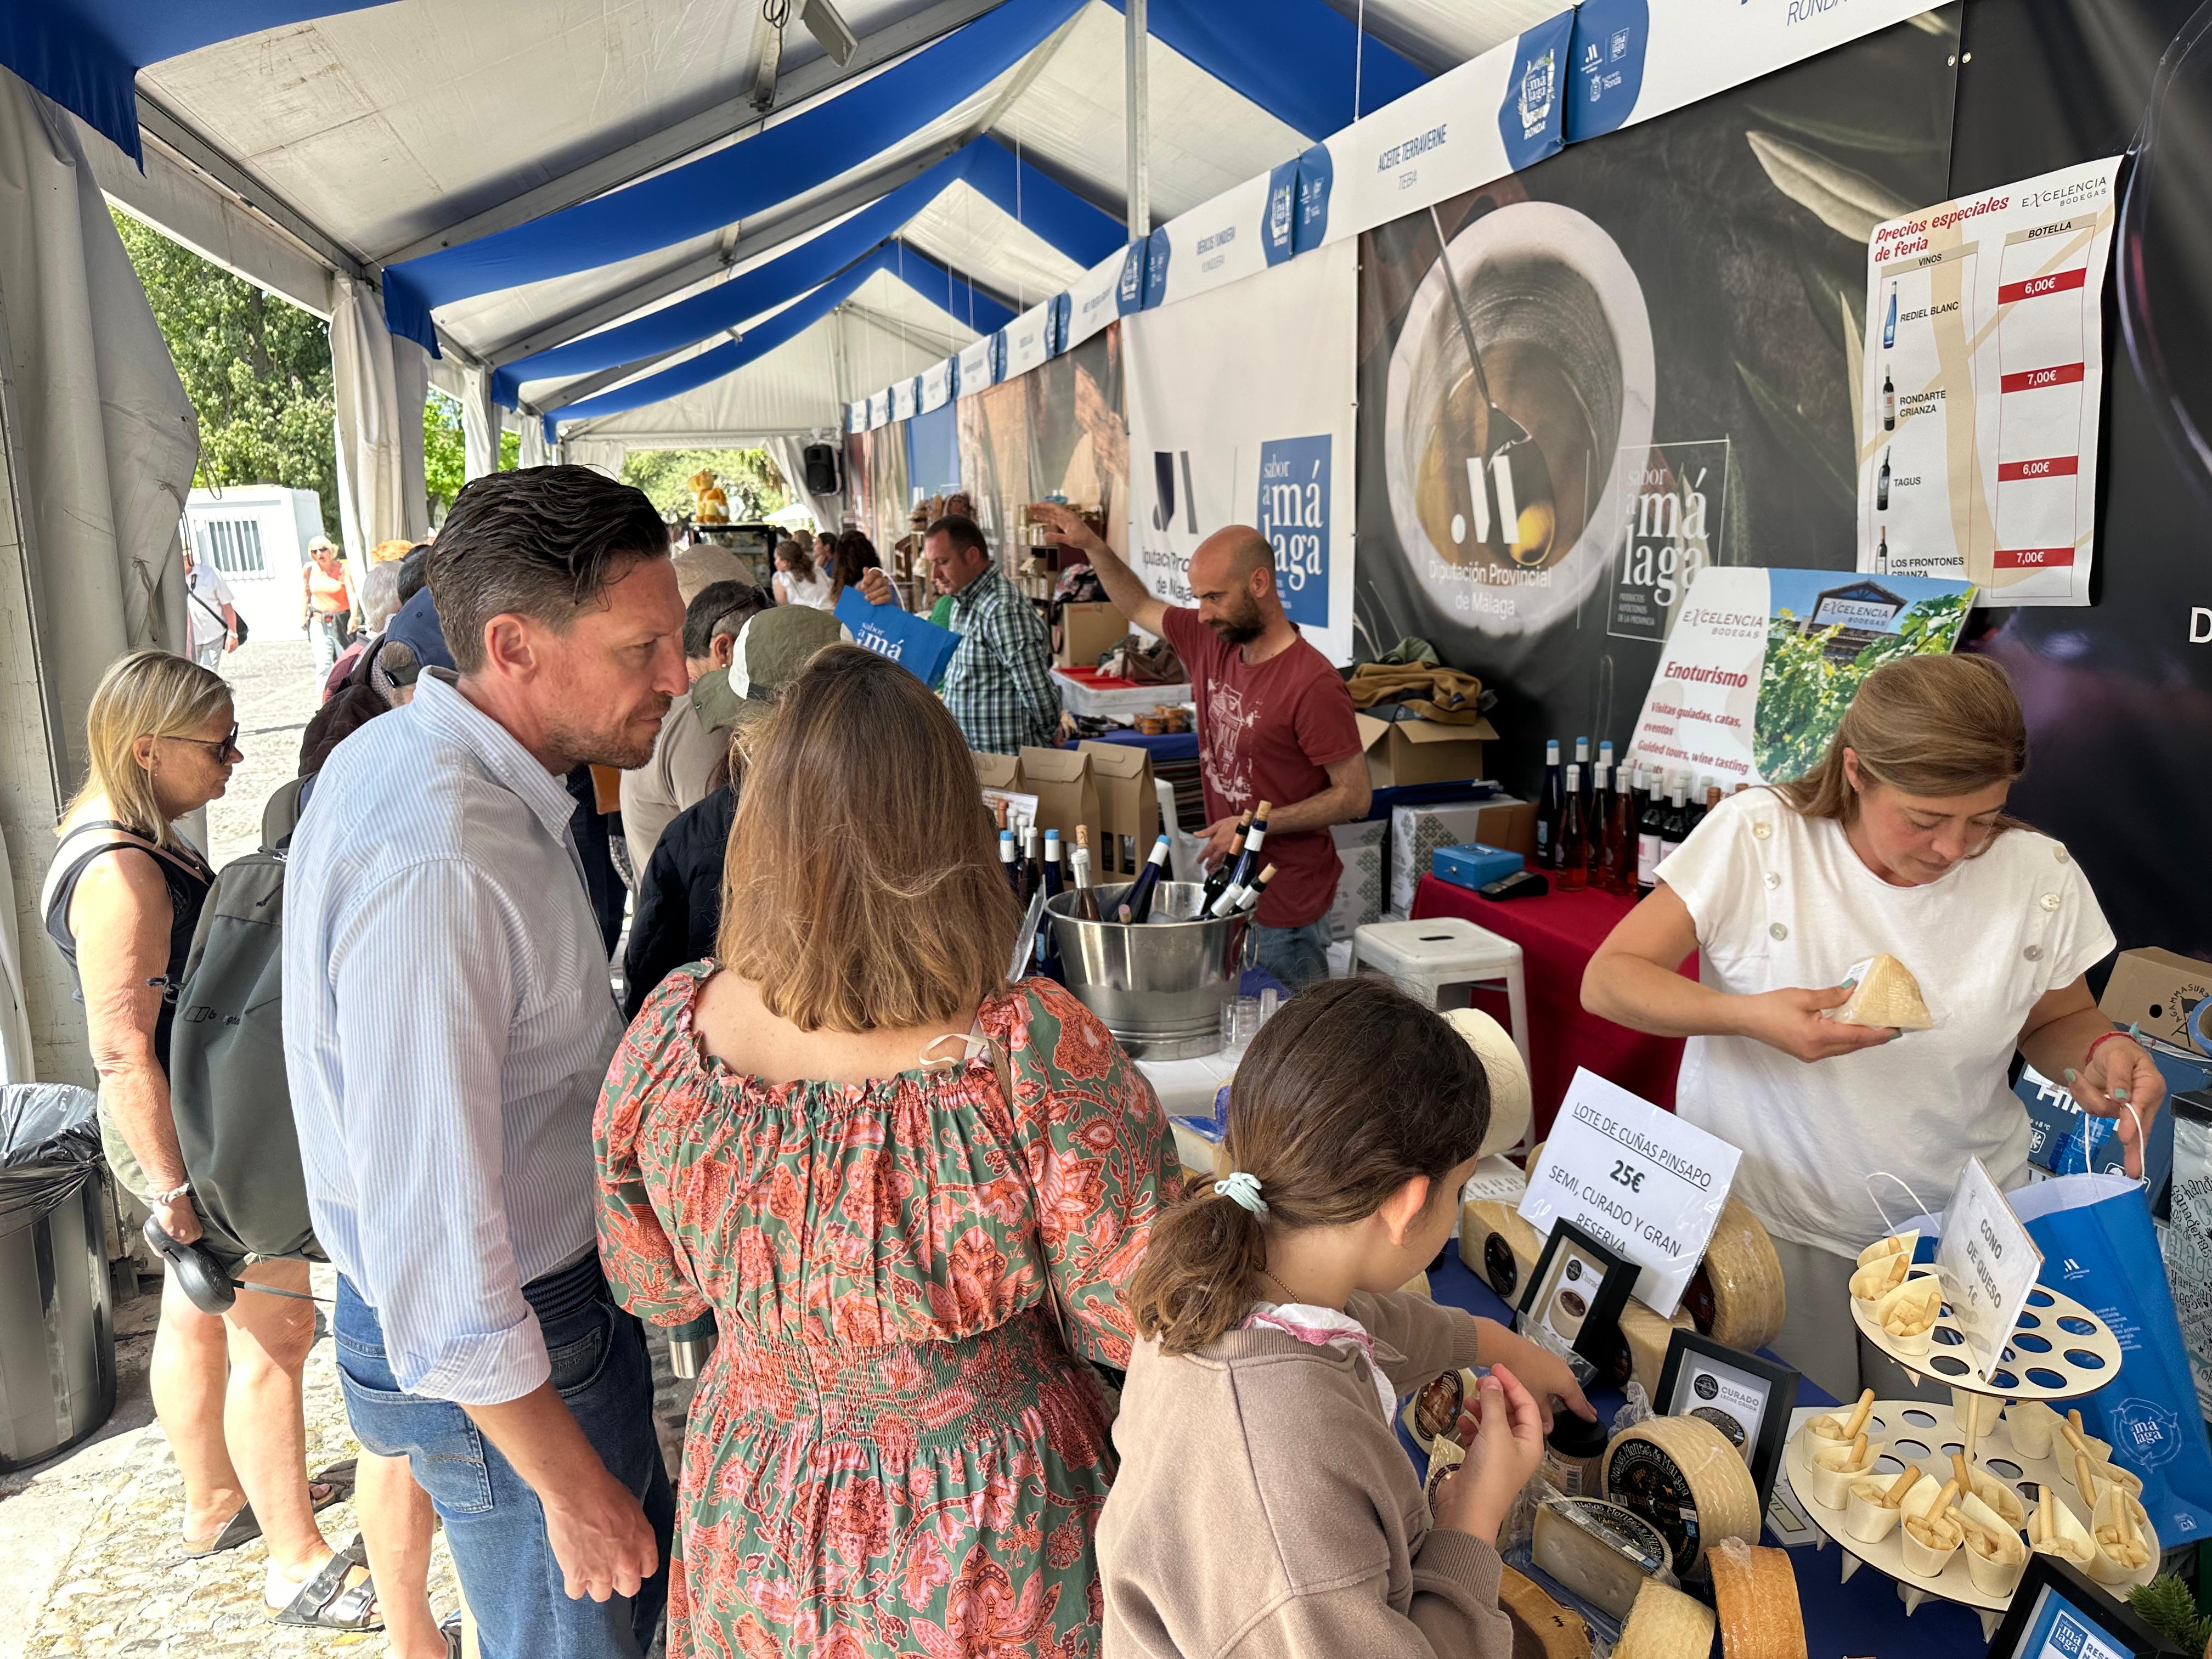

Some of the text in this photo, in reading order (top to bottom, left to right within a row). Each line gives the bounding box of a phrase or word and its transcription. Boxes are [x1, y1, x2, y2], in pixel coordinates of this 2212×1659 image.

[1787, 0, 1847, 26] RON
[2022, 176, 2107, 208] EXCELENCIA
[2059, 188, 2107, 207] BODEGAS
[1875, 195, 2009, 245] Precios especiales
[2028, 221, 2072, 239] BOTELLA
[1875, 238, 1928, 262] de feria
[1918, 253, 1942, 266] VINOS
[2024, 277, 2055, 295] 6,00€
[1900, 301, 1959, 323] REDIEL BLANC
[2027, 370, 2056, 385] 7,00€
[1899, 390, 1946, 405] RONDARTE
[1900, 405, 1937, 417] CRIANZA
[1263, 454, 1290, 478] sabor
[1628, 461, 1667, 487] sabor
[2023, 461, 2050, 476] 6,00€
[1894, 477, 1921, 487] TAGUS
[1262, 487, 1271, 505] a
[1271, 459, 1324, 528] má
[1637, 467, 1709, 540] má
[1626, 494, 1639, 515] a
[1621, 524, 1701, 606] laga
[1891, 557, 1964, 568] LOS FRONTONES
[2017, 551, 2044, 565] 7,00€
[1429, 560, 1551, 588] Diputación Provincial
[1455, 590, 1515, 620] de Málaga
[1822, 601, 1888, 618] EXCELENCIA
[862, 621, 885, 636] sabor
[1683, 608, 1763, 628] EXCELENCIA
[1847, 617, 1886, 627] BODEGAS
[857, 628, 865, 637] a
[1711, 627, 1760, 639] BODEGAS
[862, 632, 905, 662] má
[1664, 661, 1748, 689] Enoturismo
[1651, 702, 1741, 729] Visitas guiadas, catas,
[1644, 722, 1674, 736] eventos
[1637, 739, 1750, 776] Guided tours, wine tasting
[1573, 1102, 1712, 1188] LOTE DE CUÑAS PINSAPO
[1610, 1160, 1645, 1194] 25€
[1549, 1165, 1579, 1197] SEMI,
[1582, 1186, 1633, 1226] CURADO
[1633, 1216, 1644, 1234] Y
[1643, 1224, 1681, 1258] GRAN
[1980, 1218, 2003, 1260] CONO
[1581, 1271, 1601, 1290] Curad
[1966, 1239, 2002, 1310] DE QUESO
[1967, 1284, 1979, 1307] 1€
[2171, 1286, 2204, 1310] heese
[1720, 1393, 1757, 1412] LECHE CRUDA
[1721, 1386, 1759, 1406] CURADO
[2055, 1627, 2078, 1654] laga
[2061, 1626, 2083, 1646] má
[2086, 1642, 2111, 1659] RES
